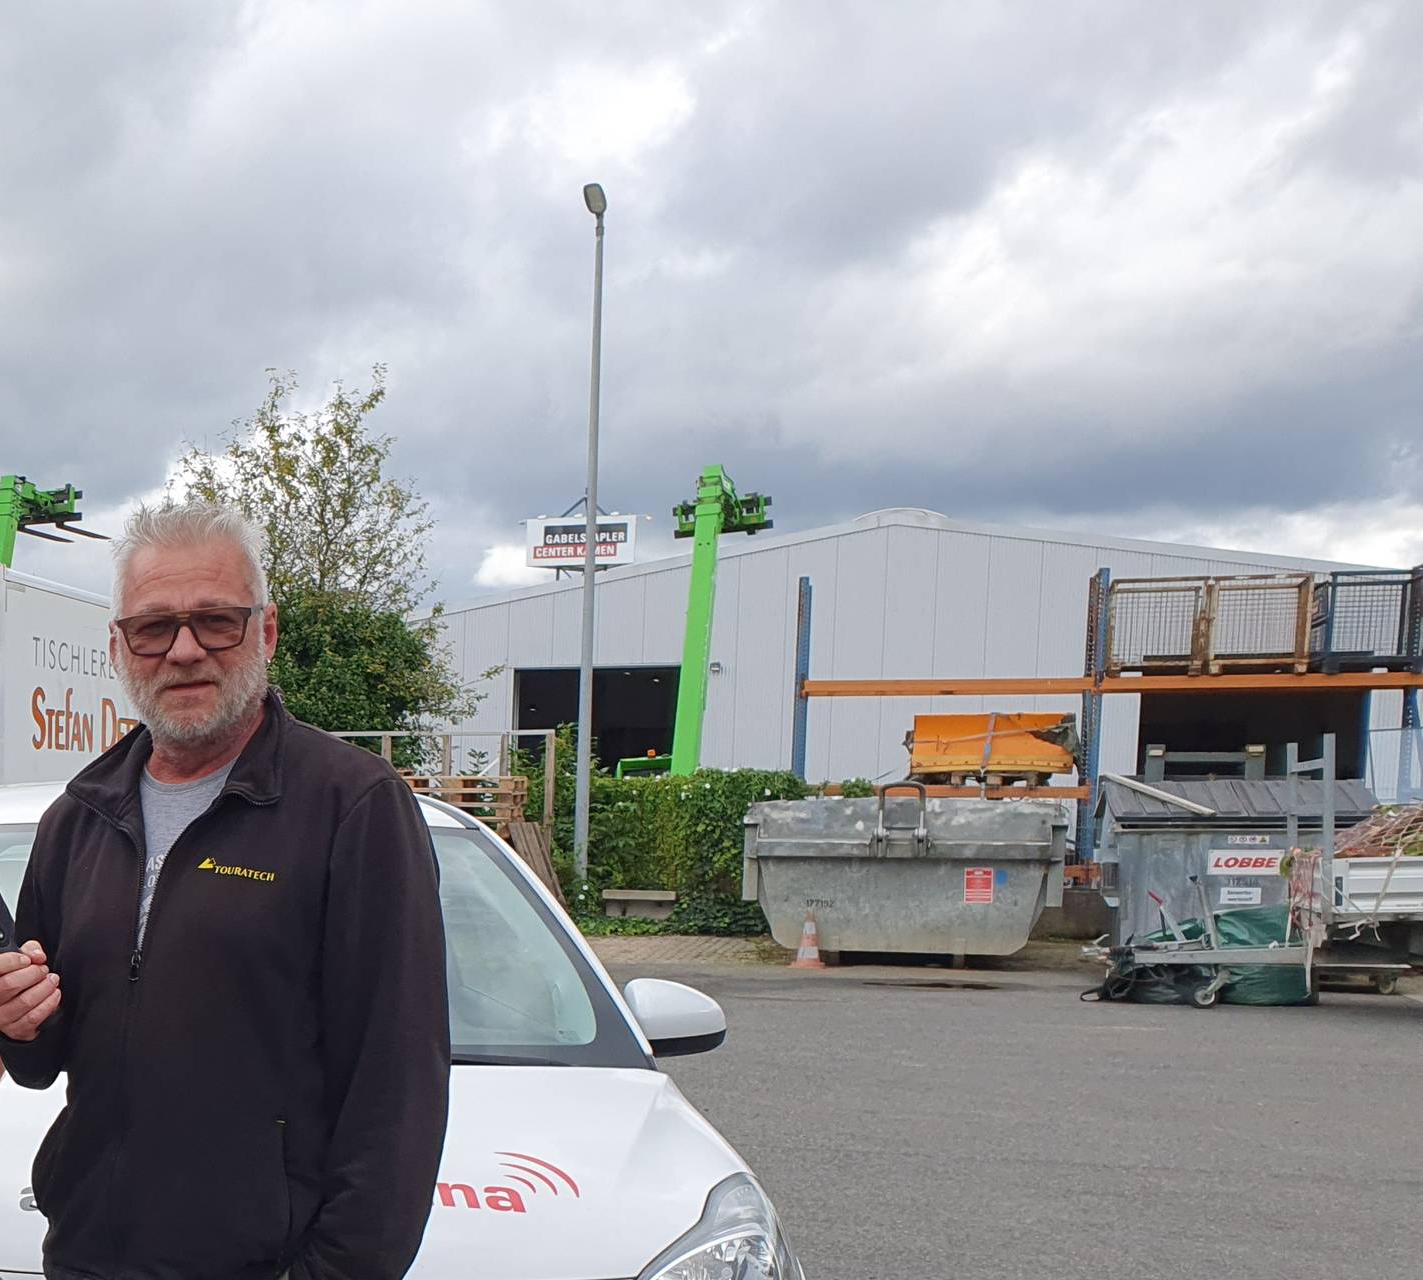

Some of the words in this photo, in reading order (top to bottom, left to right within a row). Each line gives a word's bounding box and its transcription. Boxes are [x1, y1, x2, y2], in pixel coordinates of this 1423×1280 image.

[545, 531, 625, 544] GABELSAPLER
[536, 546, 575, 557] CENTER
[1213, 857, 1279, 868] LOBBE
[214, 865, 275, 882] TOURATECH
